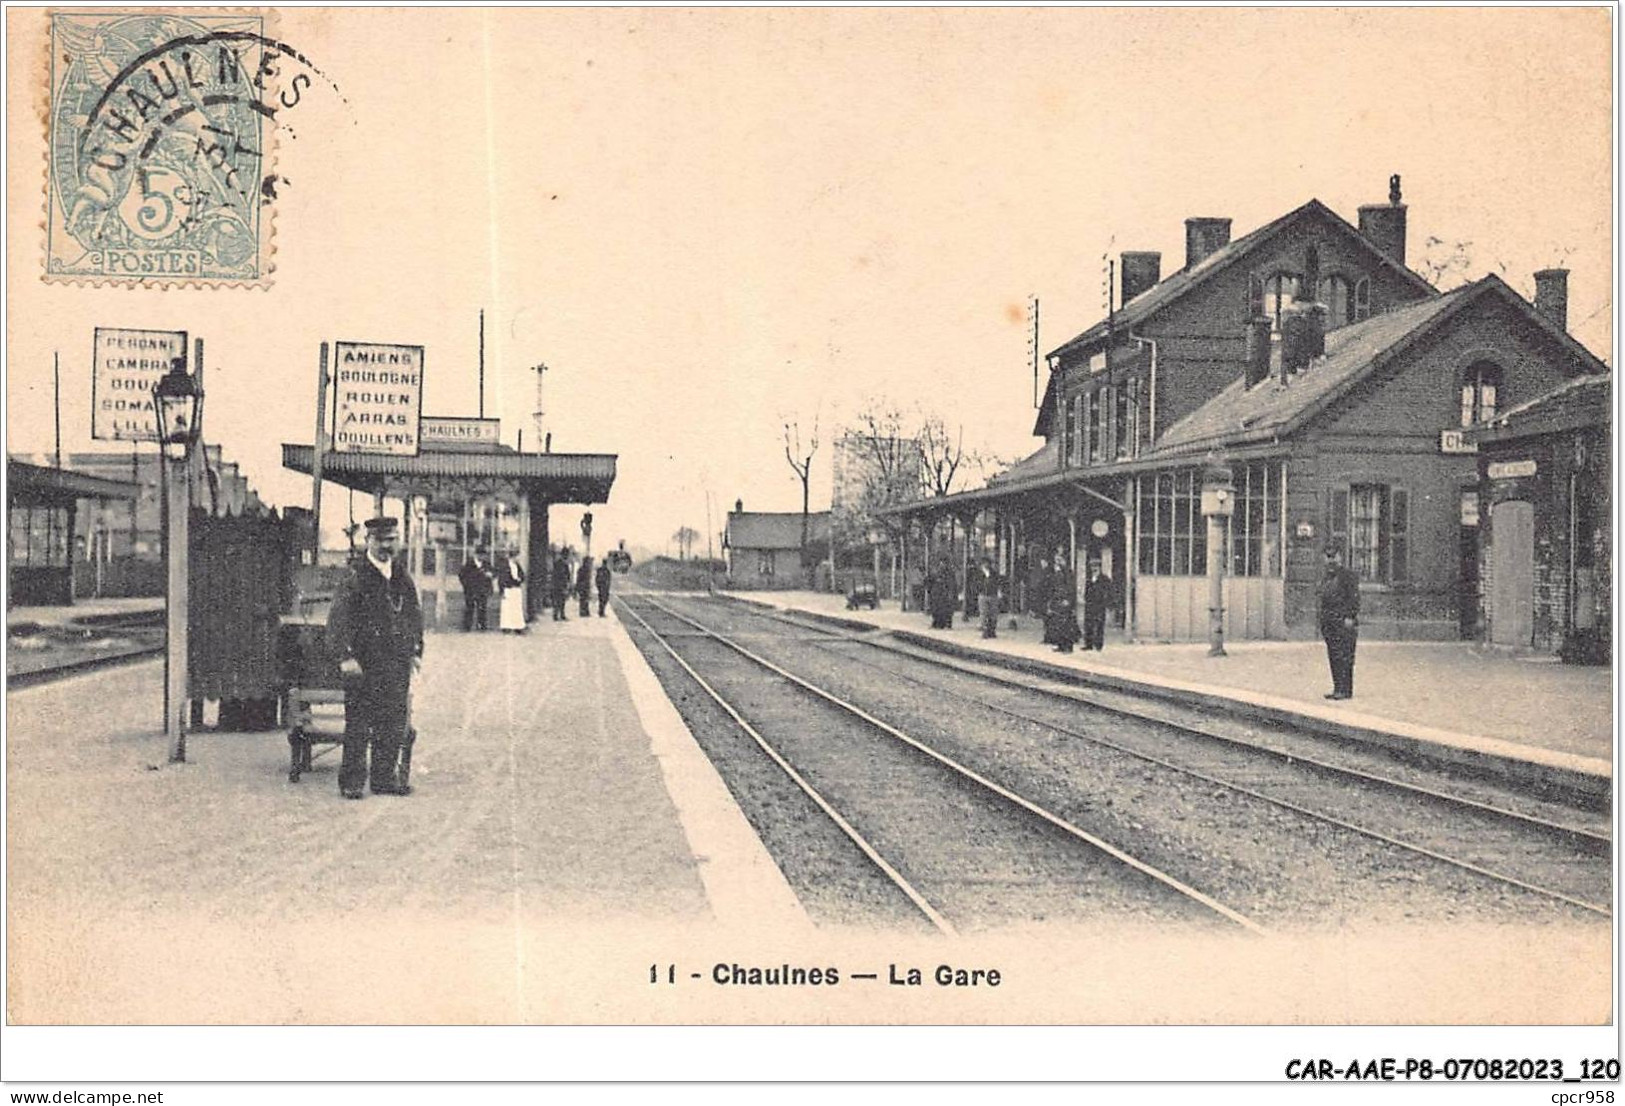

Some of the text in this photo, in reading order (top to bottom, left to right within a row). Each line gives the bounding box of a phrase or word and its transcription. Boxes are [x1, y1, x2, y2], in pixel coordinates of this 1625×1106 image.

[92, 46, 311, 171] CHAULNES
[136, 167, 174, 233] 5
[107, 251, 197, 274] POSTES
[106, 359, 169, 371] CAMBRA
[344, 351, 412, 365] AMIENS
[340, 370, 419, 386] BOULOGNE
[346, 392, 410, 406] ROUEN
[113, 420, 154, 432] LILL
[344, 412, 407, 426] ARRAS
[421, 423, 481, 438] CHAULNES
[338, 431, 414, 446] DOULLENS
